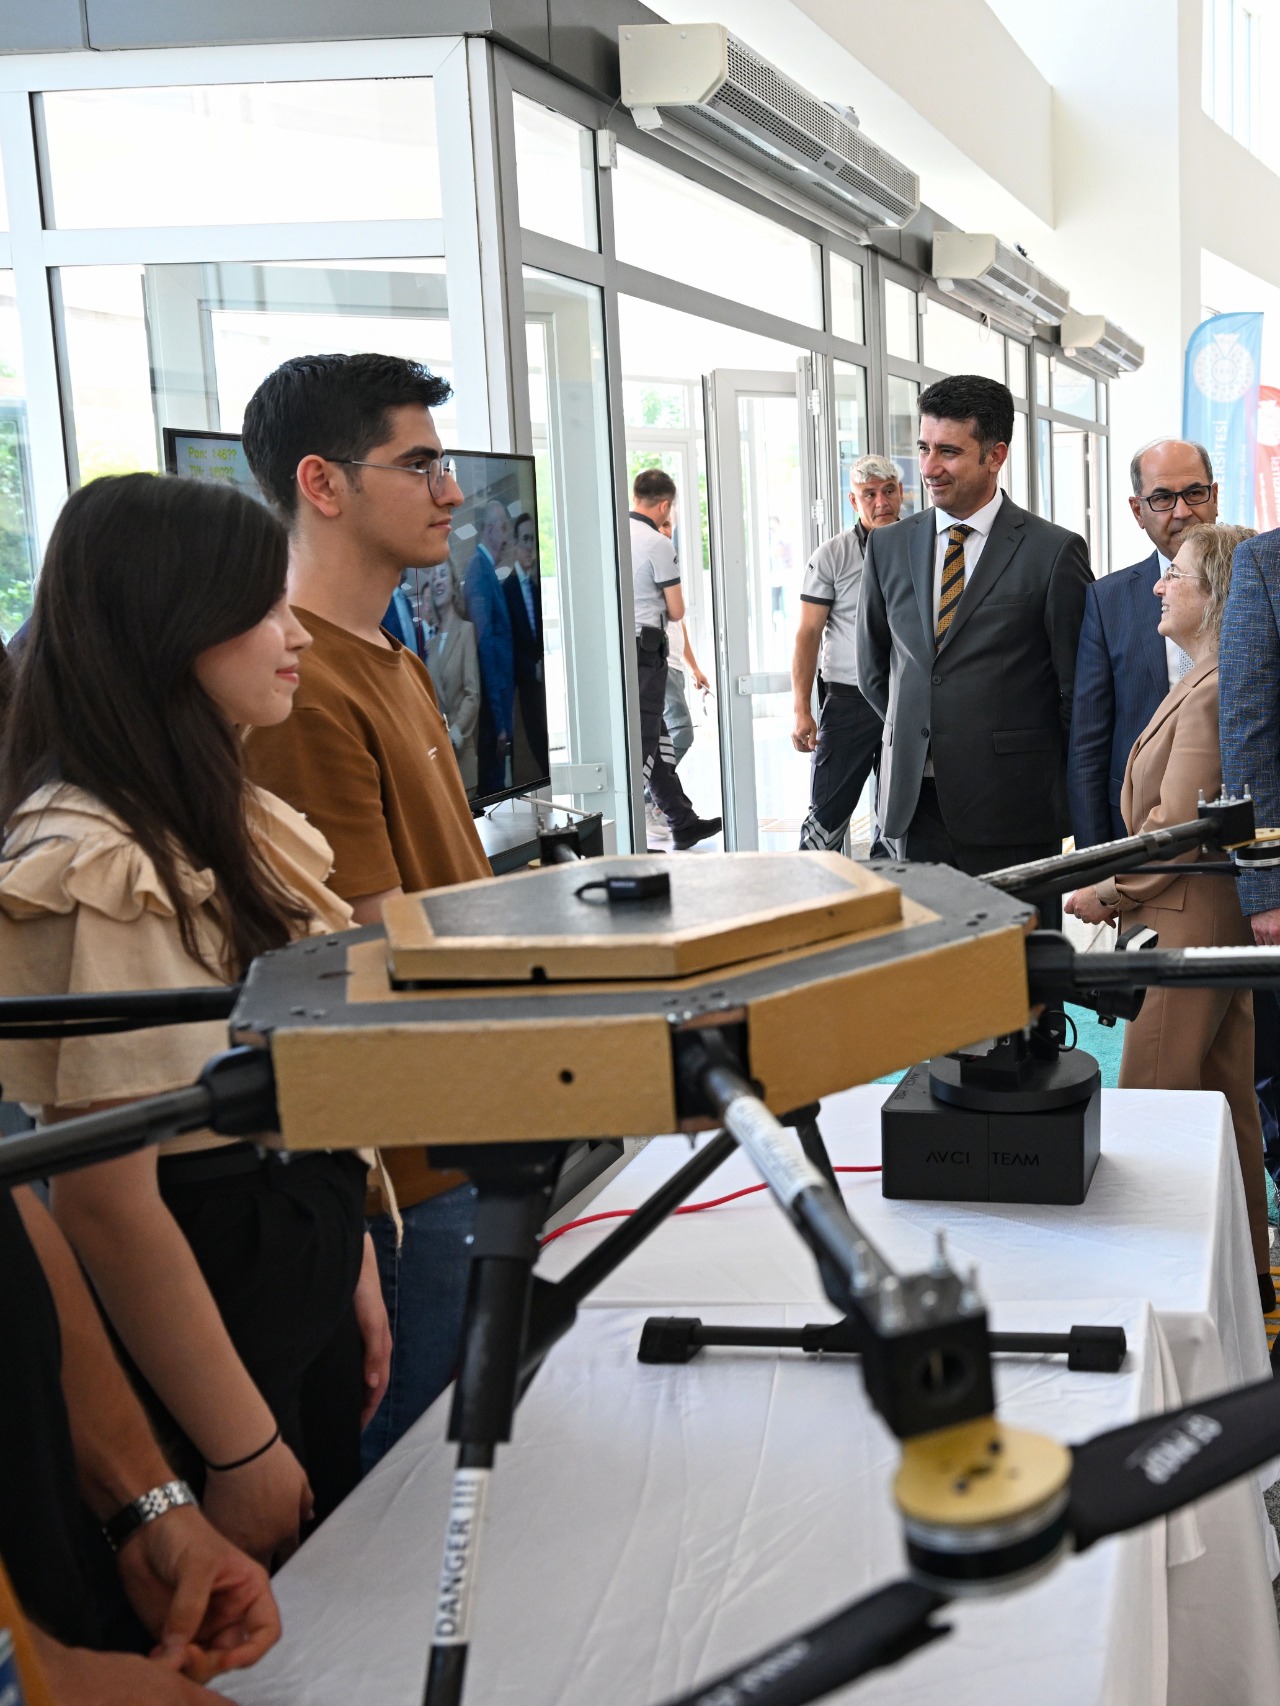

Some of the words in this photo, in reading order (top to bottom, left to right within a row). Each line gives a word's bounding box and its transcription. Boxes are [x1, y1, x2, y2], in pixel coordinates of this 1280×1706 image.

[926, 1151, 970, 1165] AVCI
[992, 1152, 1040, 1167] TEAM
[435, 1519, 470, 1638] DANGER
